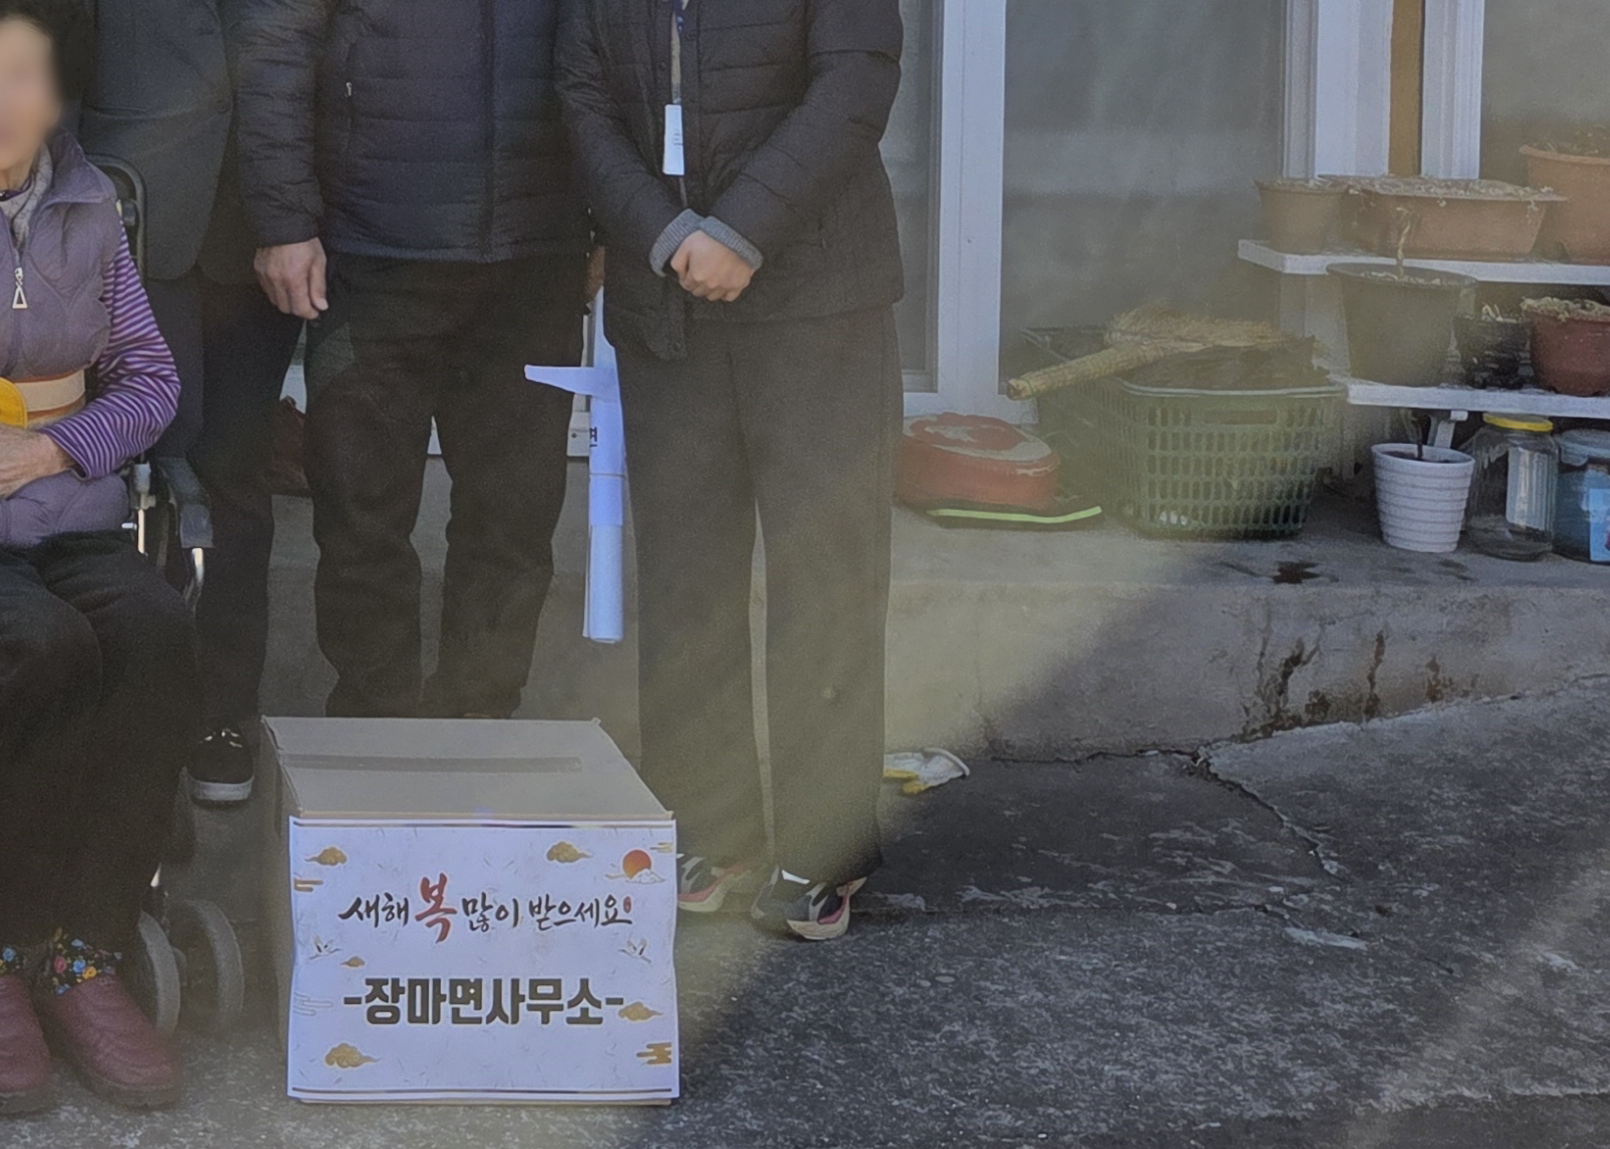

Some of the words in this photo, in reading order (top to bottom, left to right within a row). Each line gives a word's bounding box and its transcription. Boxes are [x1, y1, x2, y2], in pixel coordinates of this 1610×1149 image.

[338, 892, 409, 928] 새해
[414, 872, 458, 943] 복
[461, 893, 519, 933] 많이
